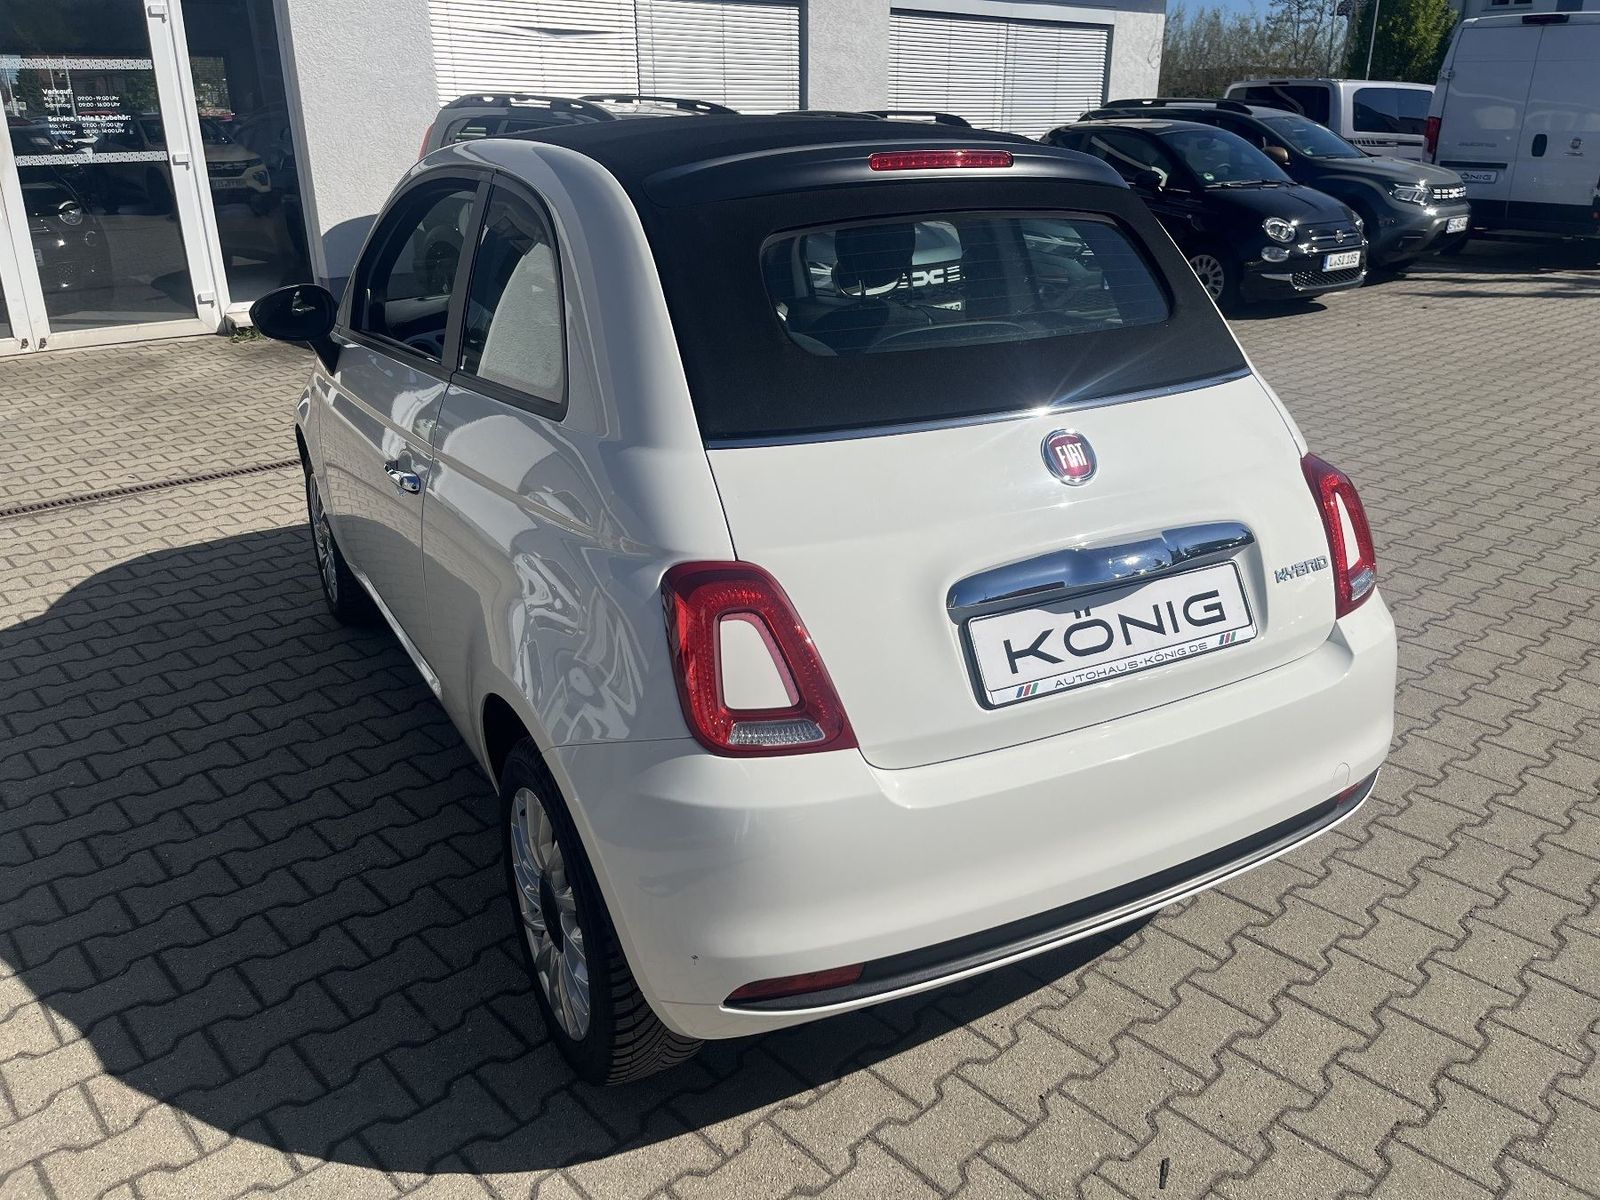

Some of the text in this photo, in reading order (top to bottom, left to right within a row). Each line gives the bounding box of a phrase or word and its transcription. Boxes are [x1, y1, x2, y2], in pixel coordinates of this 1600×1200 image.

[1460, 171, 1492, 181] ÖNIG
[1055, 442, 1088, 470] FIAT
[1274, 555, 1328, 583] HYBRID
[1003, 589, 1227, 675] KÖNIG
[1054, 641, 1208, 689] AUTOHAUS-KÖNIG.DE
